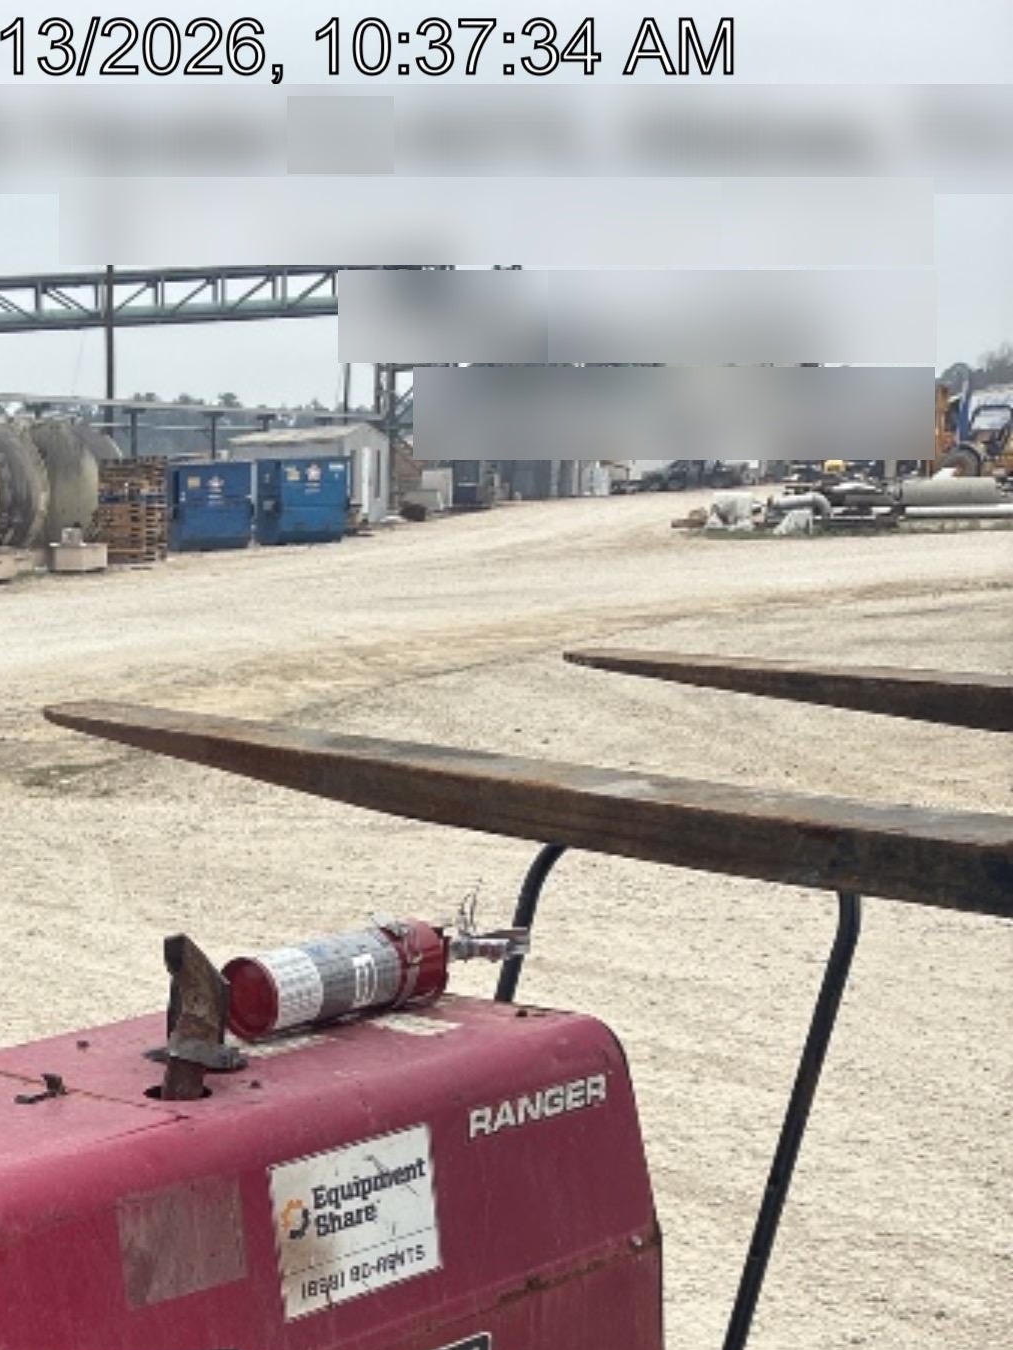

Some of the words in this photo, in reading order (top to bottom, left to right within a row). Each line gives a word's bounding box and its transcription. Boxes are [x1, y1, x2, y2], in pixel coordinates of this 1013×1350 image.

[469, 1073, 607, 1139] RANGER
[311, 1157, 426, 1209] Equipment
[314, 1202, 379, 1238] Share
